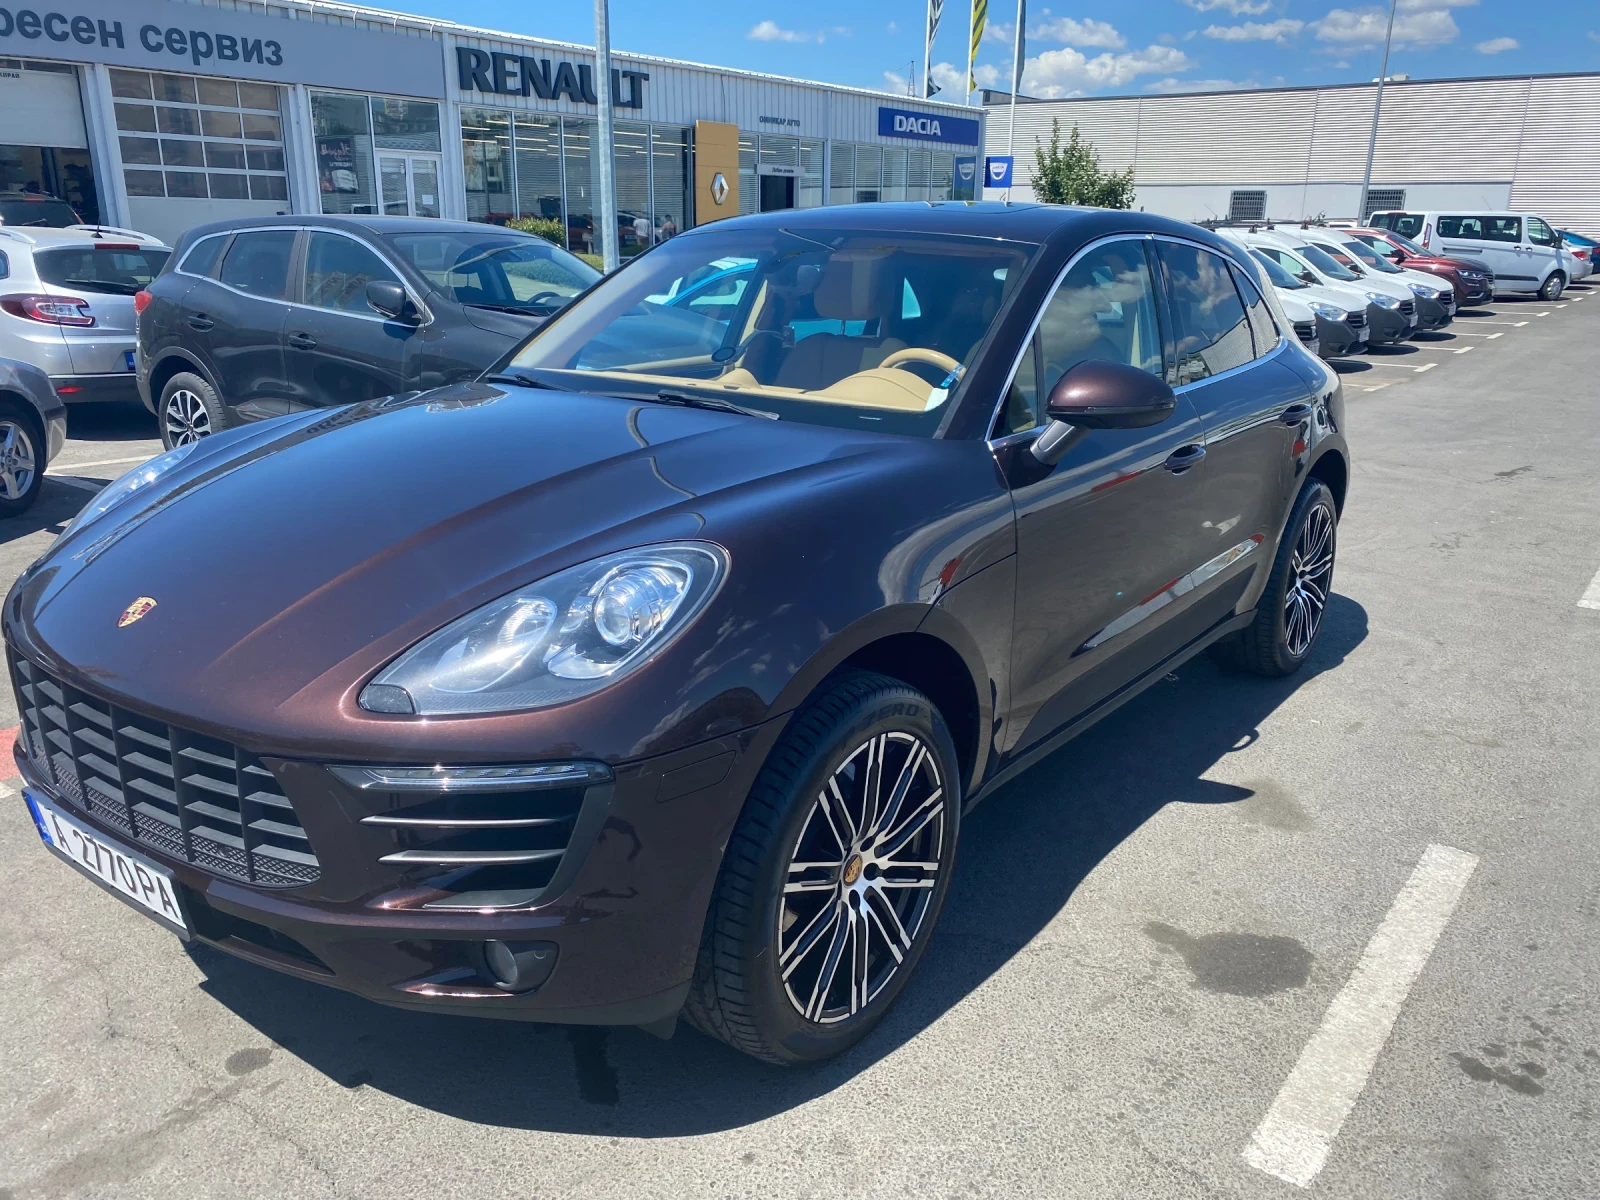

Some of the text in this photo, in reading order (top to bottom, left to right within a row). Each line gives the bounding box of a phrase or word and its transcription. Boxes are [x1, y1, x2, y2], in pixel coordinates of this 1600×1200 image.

[140, 24, 284, 66] сервиз
[455, 47, 649, 109] RENAULT
[893, 114, 942, 137] DACIA
